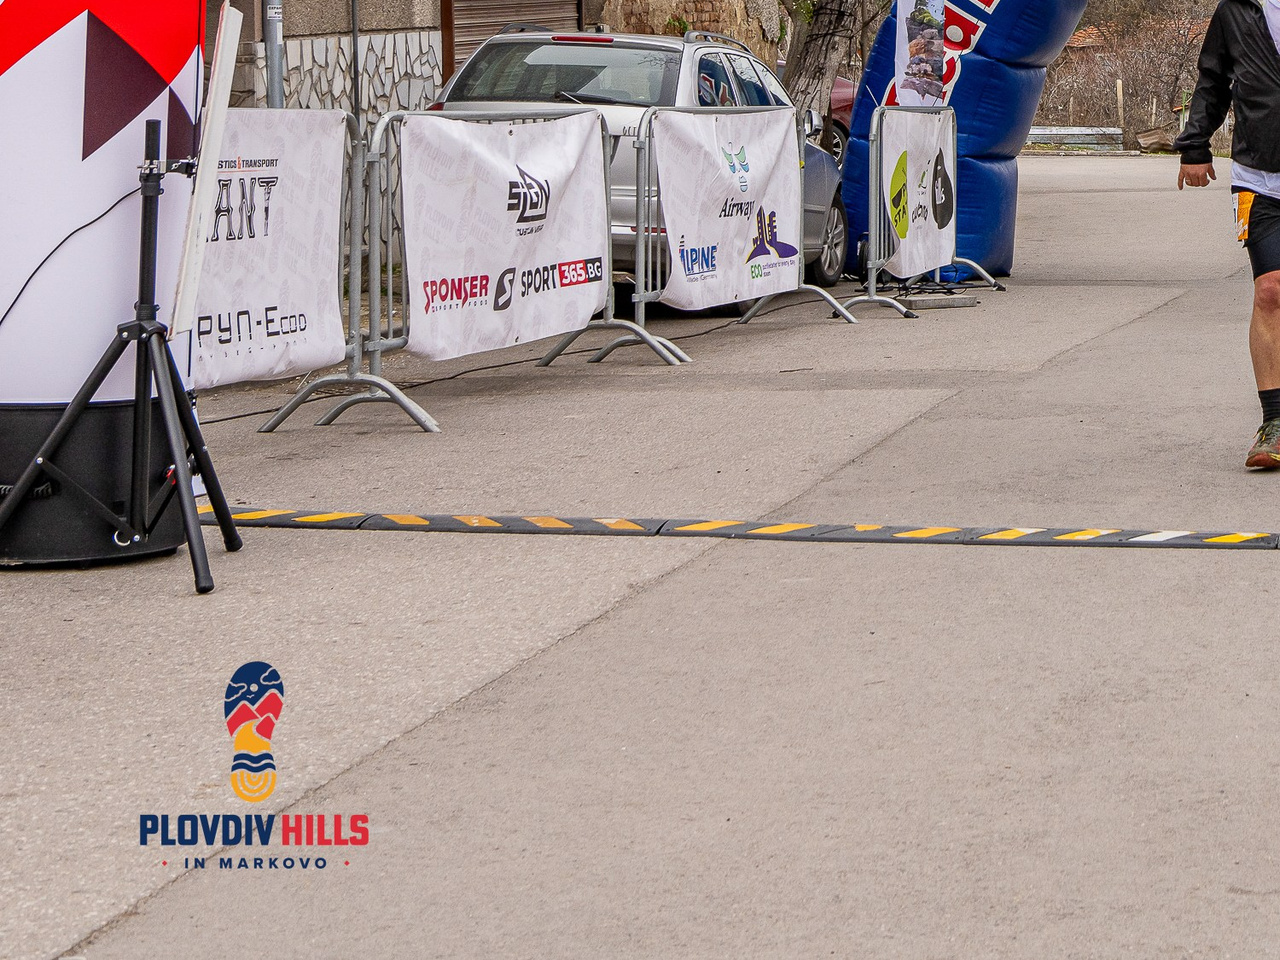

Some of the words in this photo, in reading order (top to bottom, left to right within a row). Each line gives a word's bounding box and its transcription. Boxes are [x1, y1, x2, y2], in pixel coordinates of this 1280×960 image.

[242, 158, 279, 168] TRANSPORT
[206, 176, 279, 243] ANT
[719, 196, 756, 221] Airway
[750, 264, 763, 279] ECO
[423, 274, 490, 315] SPONSER
